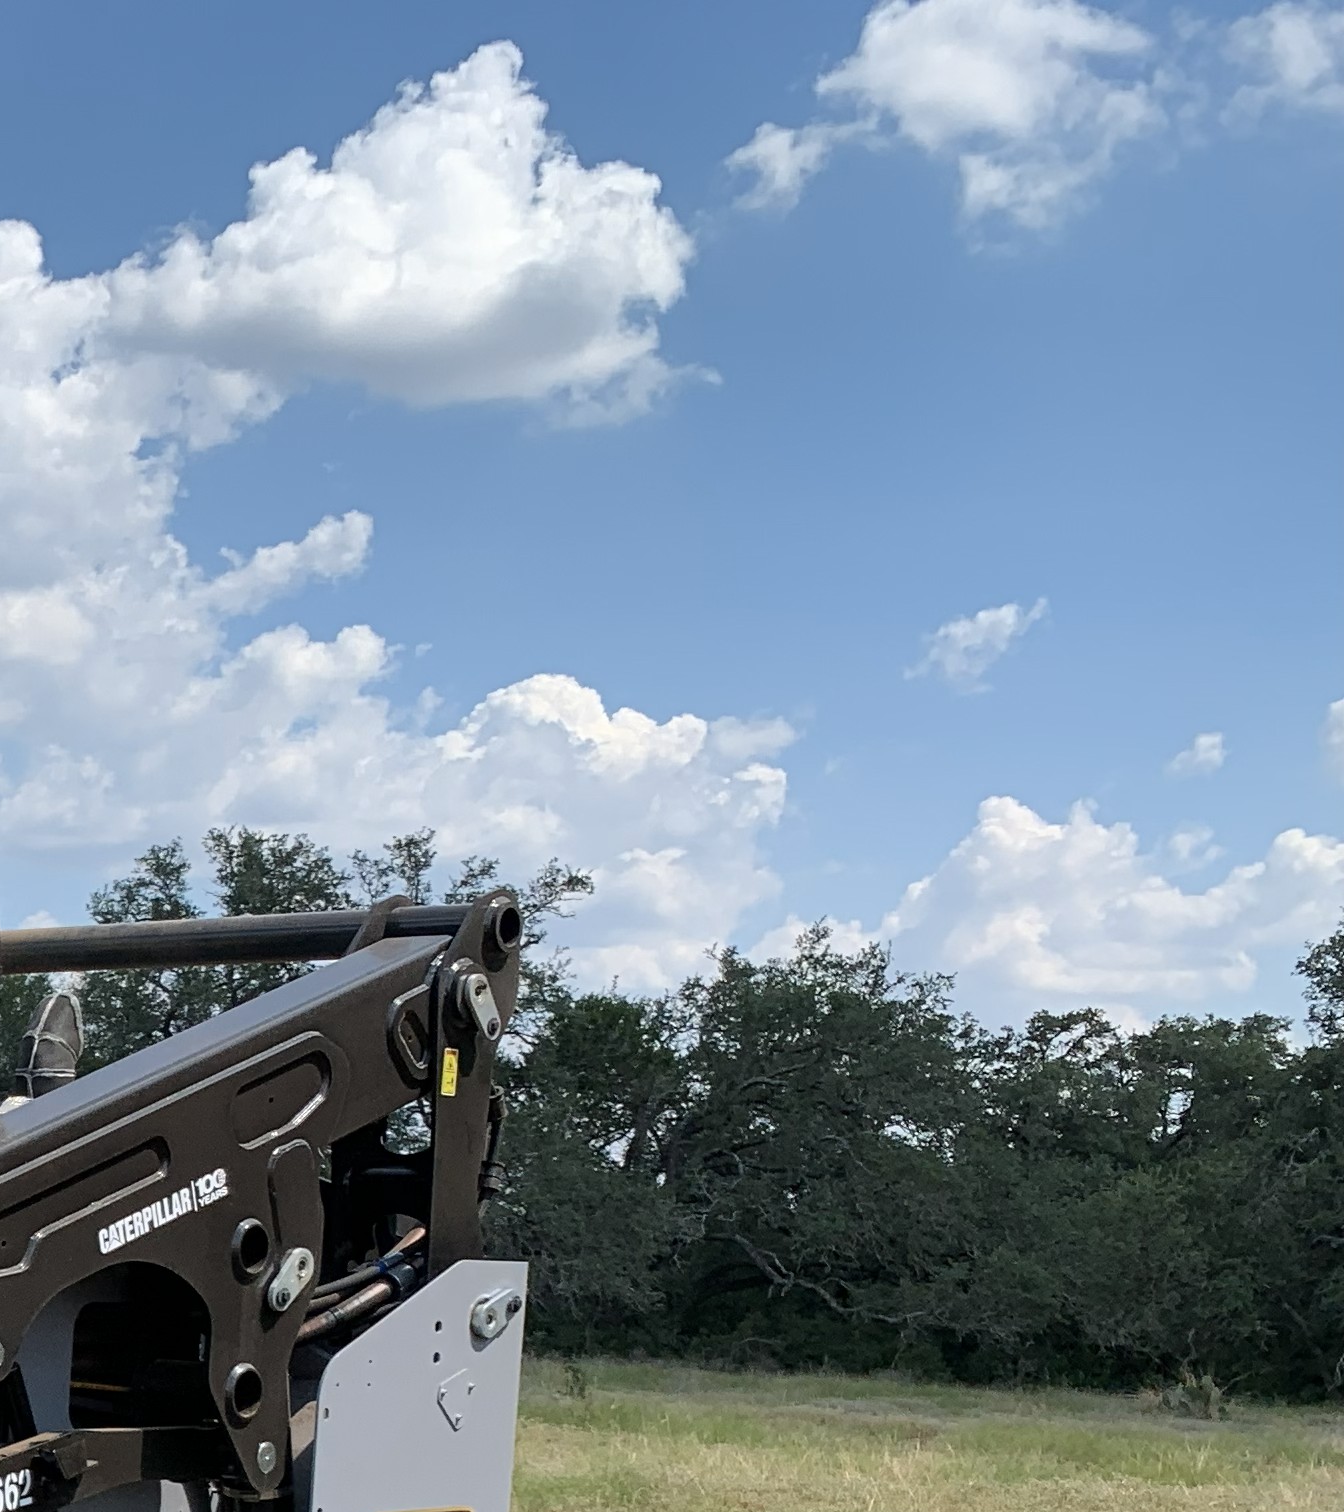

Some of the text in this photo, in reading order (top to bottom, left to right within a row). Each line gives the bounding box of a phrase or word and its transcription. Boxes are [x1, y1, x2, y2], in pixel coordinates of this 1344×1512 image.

[195, 1168, 227, 1197] 100
[198, 1186, 229, 1207] YEARS
[98, 1187, 192, 1255] CATERPILLAR
